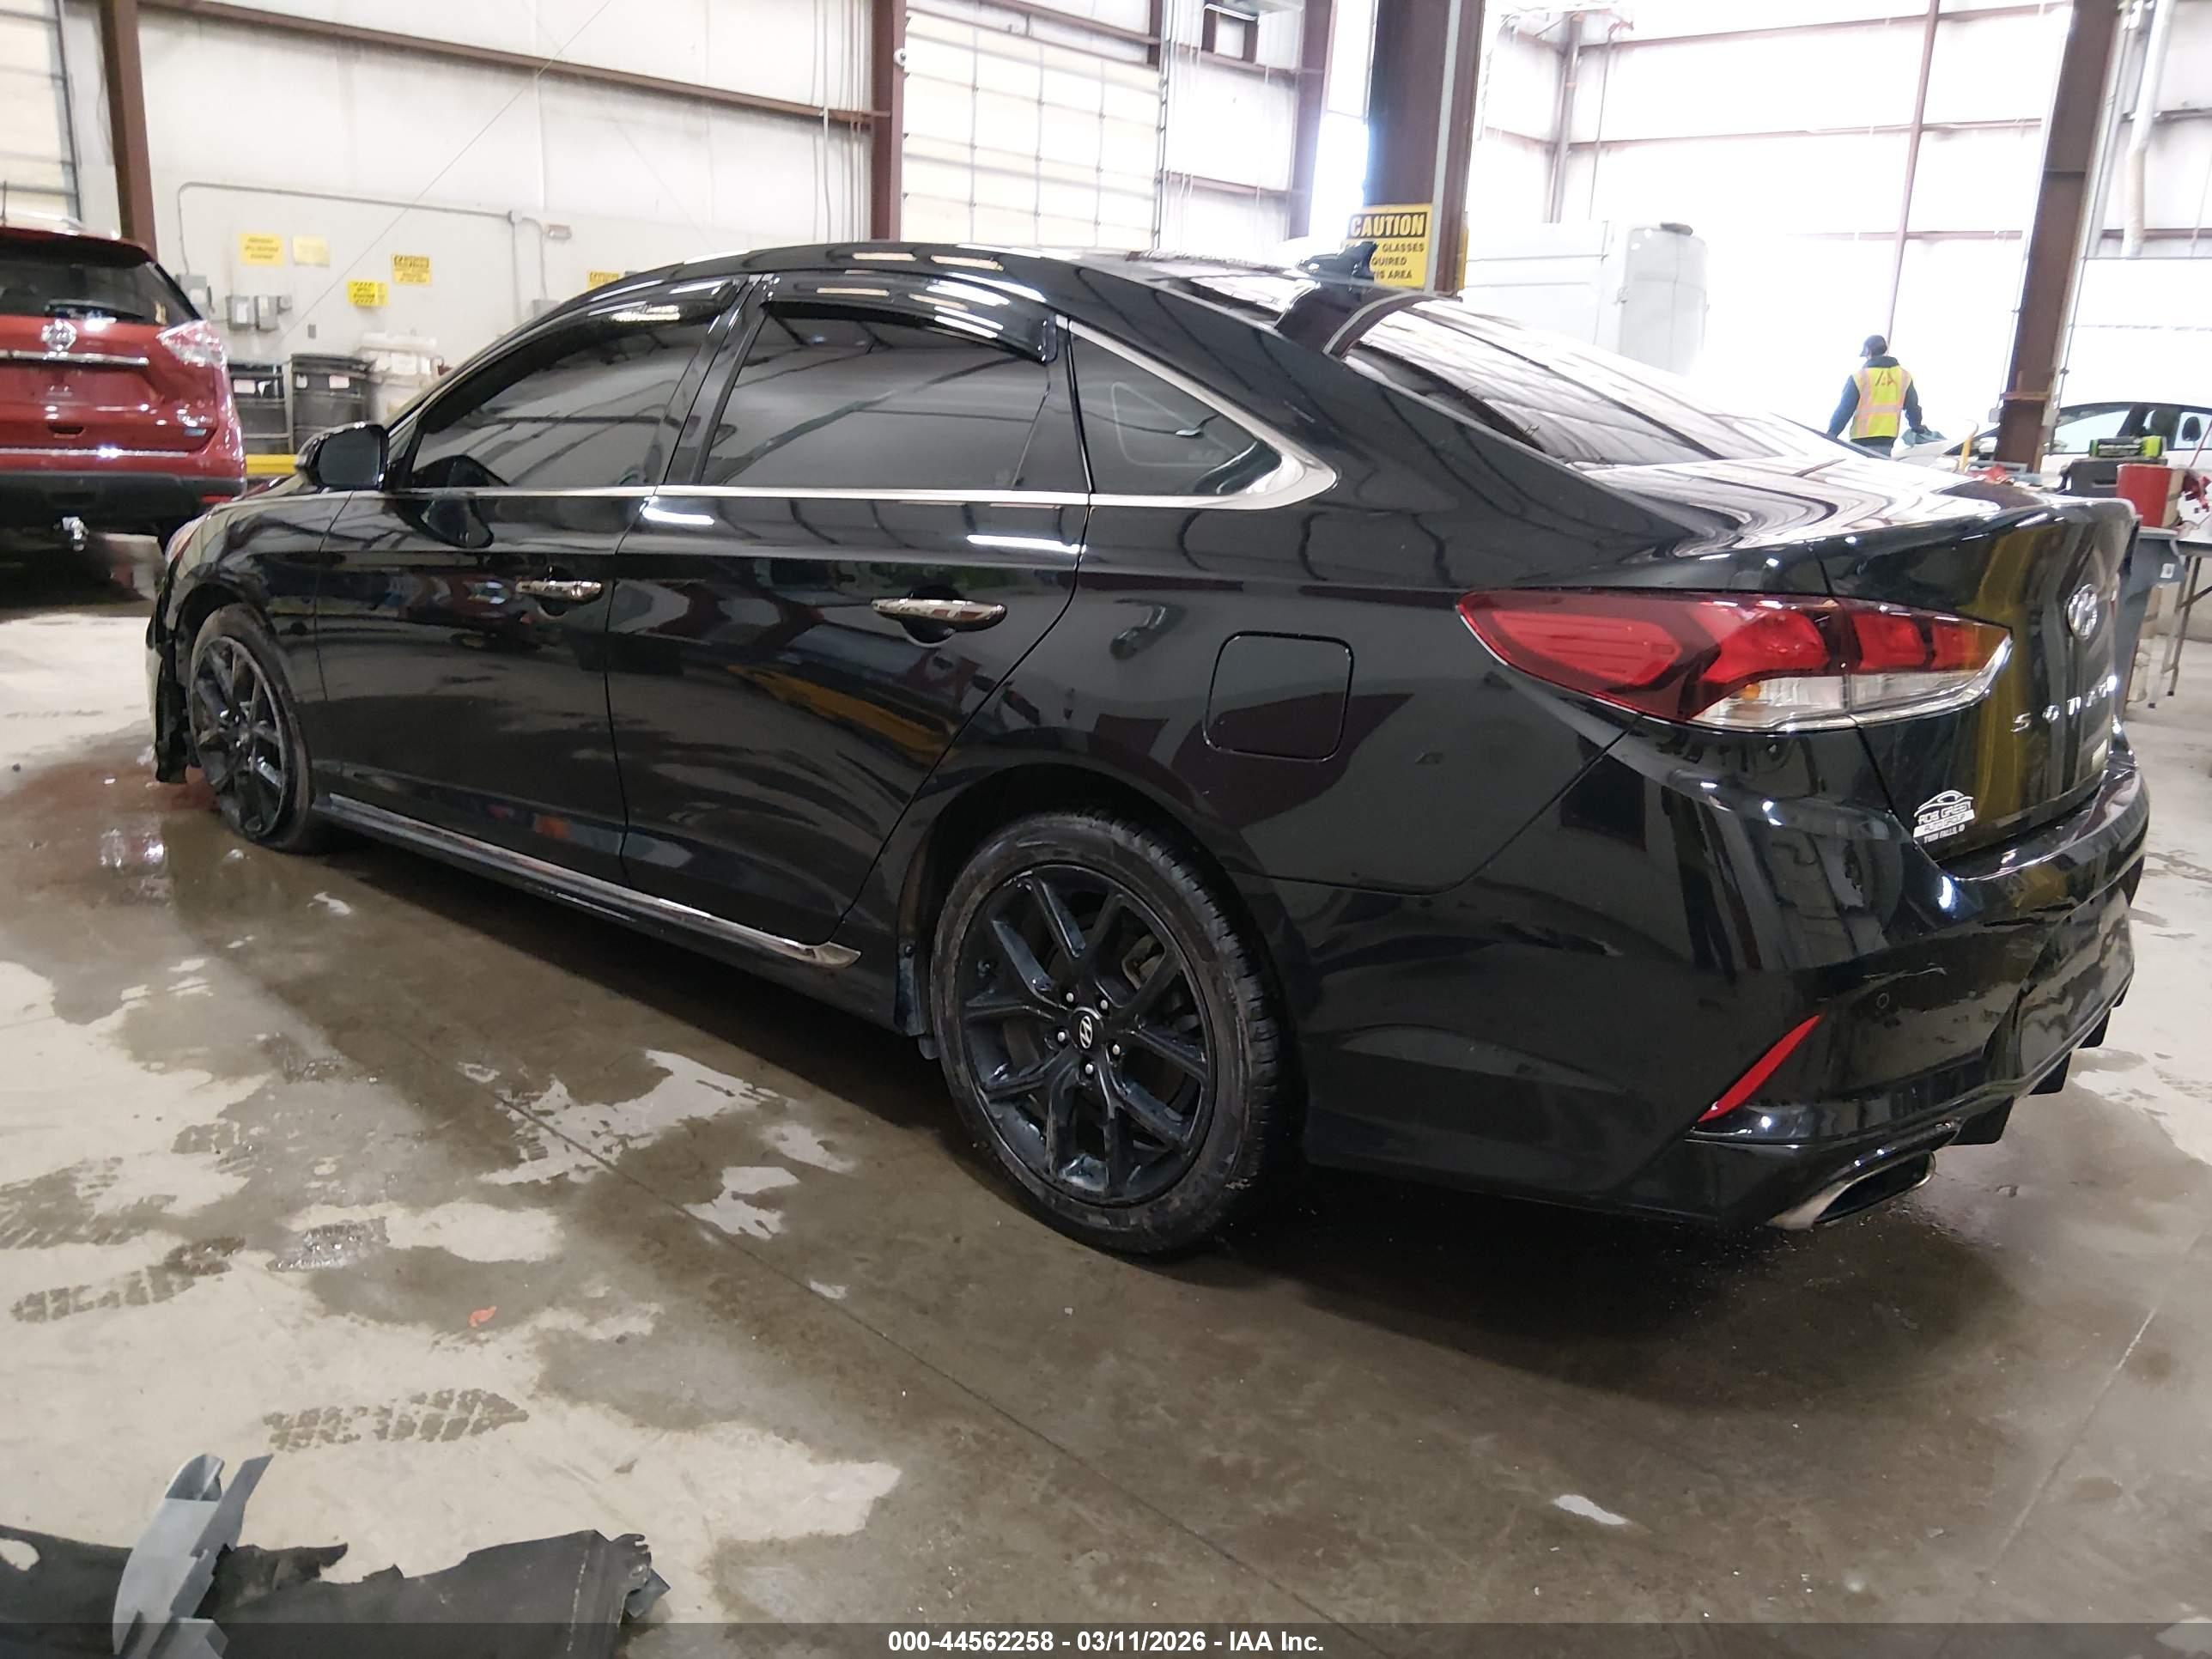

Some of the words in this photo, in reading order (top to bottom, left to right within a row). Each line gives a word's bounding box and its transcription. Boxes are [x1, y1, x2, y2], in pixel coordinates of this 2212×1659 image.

[1350, 214, 1425, 237] CAUTION
[1382, 243, 1425, 252] GLASSES
[1371, 257, 1407, 266] QUIRED
[1387, 270, 1413, 279] AREA
[2010, 676, 2118, 732] SONT
